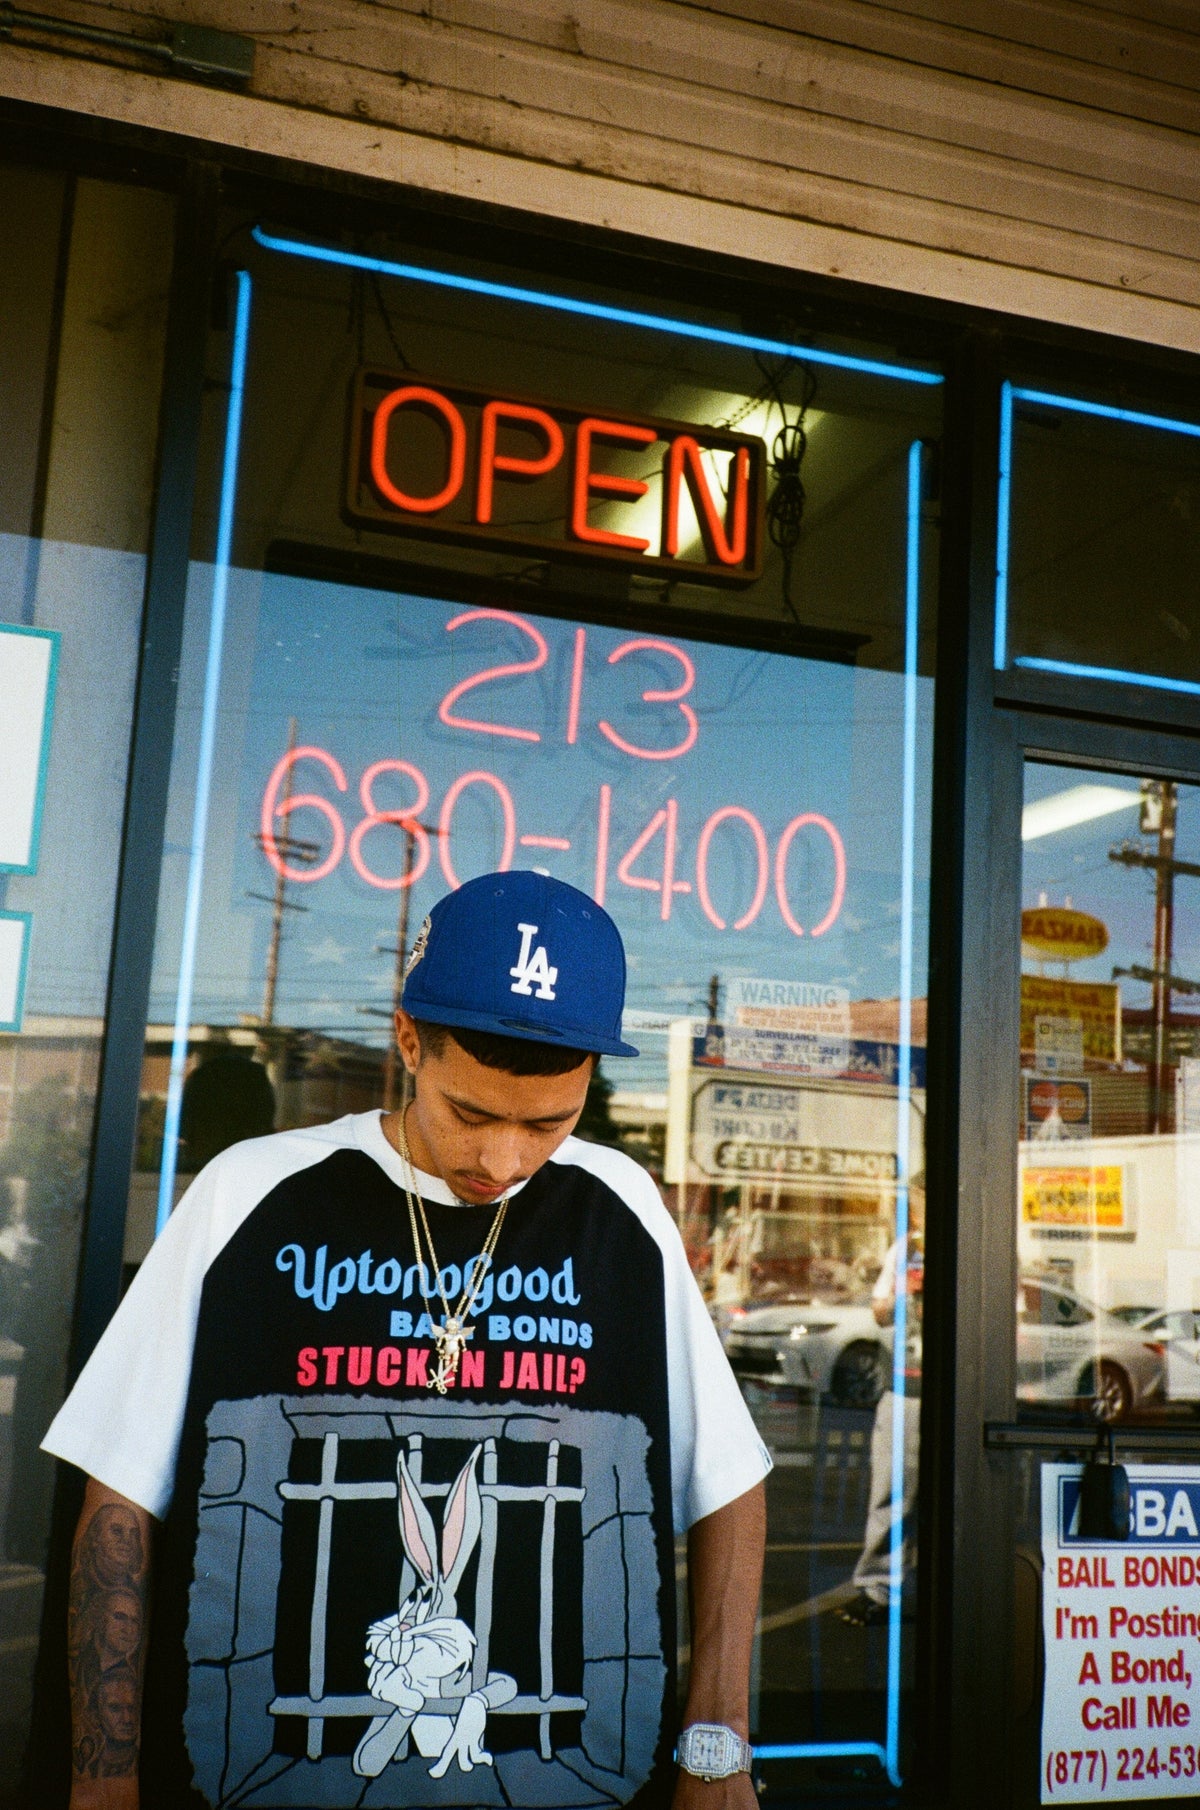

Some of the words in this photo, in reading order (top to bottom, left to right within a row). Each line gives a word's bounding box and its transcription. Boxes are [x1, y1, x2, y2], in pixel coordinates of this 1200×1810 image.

[370, 386, 751, 566] OPEN
[438, 608, 699, 761] 213
[260, 745, 847, 937] 680-1400
[509, 922, 558, 1000] LA
[740, 982, 838, 1008] WARNING
[488, 1314, 594, 1350] BONDS
[296, 1346, 431, 1388] STUCK
[499, 1351, 586, 1394] JAIL?
[1068, 1490, 1199, 1537] BA
[1057, 1556, 1116, 1588] BAIL
[1055, 1607, 1099, 1640] I'm
[1109, 1605, 1200, 1643] Postin
[1078, 1651, 1102, 1686] A
[1111, 1649, 1193, 1690] Bond,
[1081, 1696, 1137, 1731] Call
[1146, 1695, 1192, 1729] Me
[1046, 1750, 1108, 1793] (877)
[1116, 1744, 1200, 1782] 224-53
